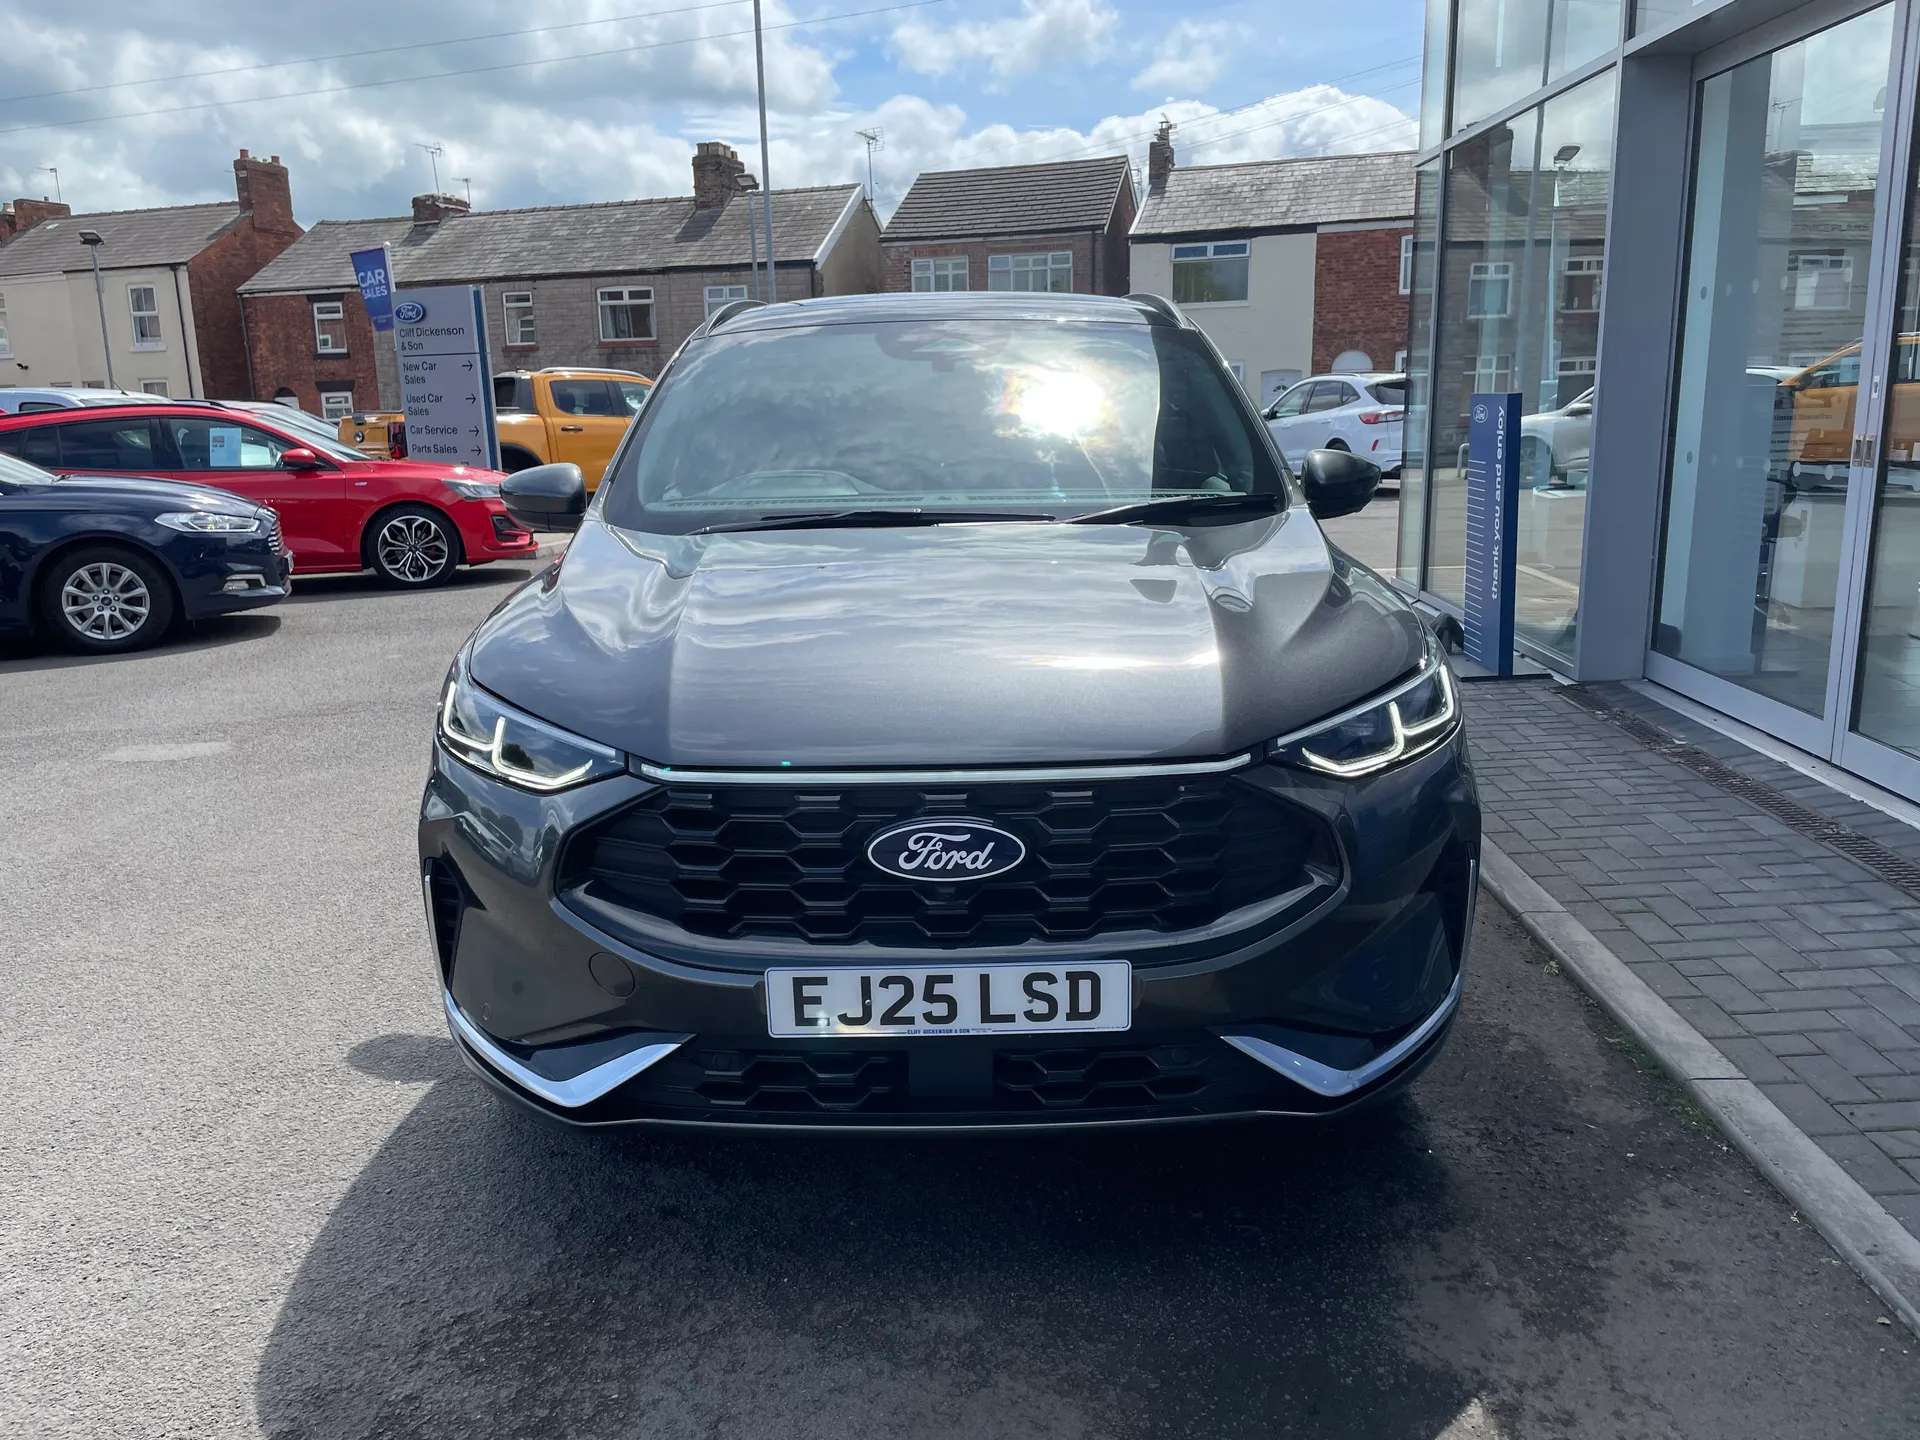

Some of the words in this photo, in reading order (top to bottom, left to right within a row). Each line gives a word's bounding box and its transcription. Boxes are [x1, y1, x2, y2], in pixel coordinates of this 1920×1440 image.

[358, 268, 385, 287] CAR
[362, 285, 388, 299] SALES
[399, 327, 415, 338] Cliff
[416, 326, 464, 337] Dickenson
[401, 342, 407, 351] &
[408, 341, 424, 350] Son
[403, 362, 420, 372] New
[421, 361, 437, 371] Car
[405, 374, 426, 384] Sales
[406, 393, 426, 403] Used
[427, 393, 443, 403] Car
[408, 406, 429, 416] Sales
[410, 425, 423, 435] Car
[424, 424, 458, 435] Service
[1496, 406, 1505, 460] enjoy
[411, 444, 432, 454] Parts
[433, 443, 458, 454] Sales
[899, 832, 994, 870] Ford
[792, 974, 958, 1027] EJ25
[979, 970, 1101, 1025] LSD
